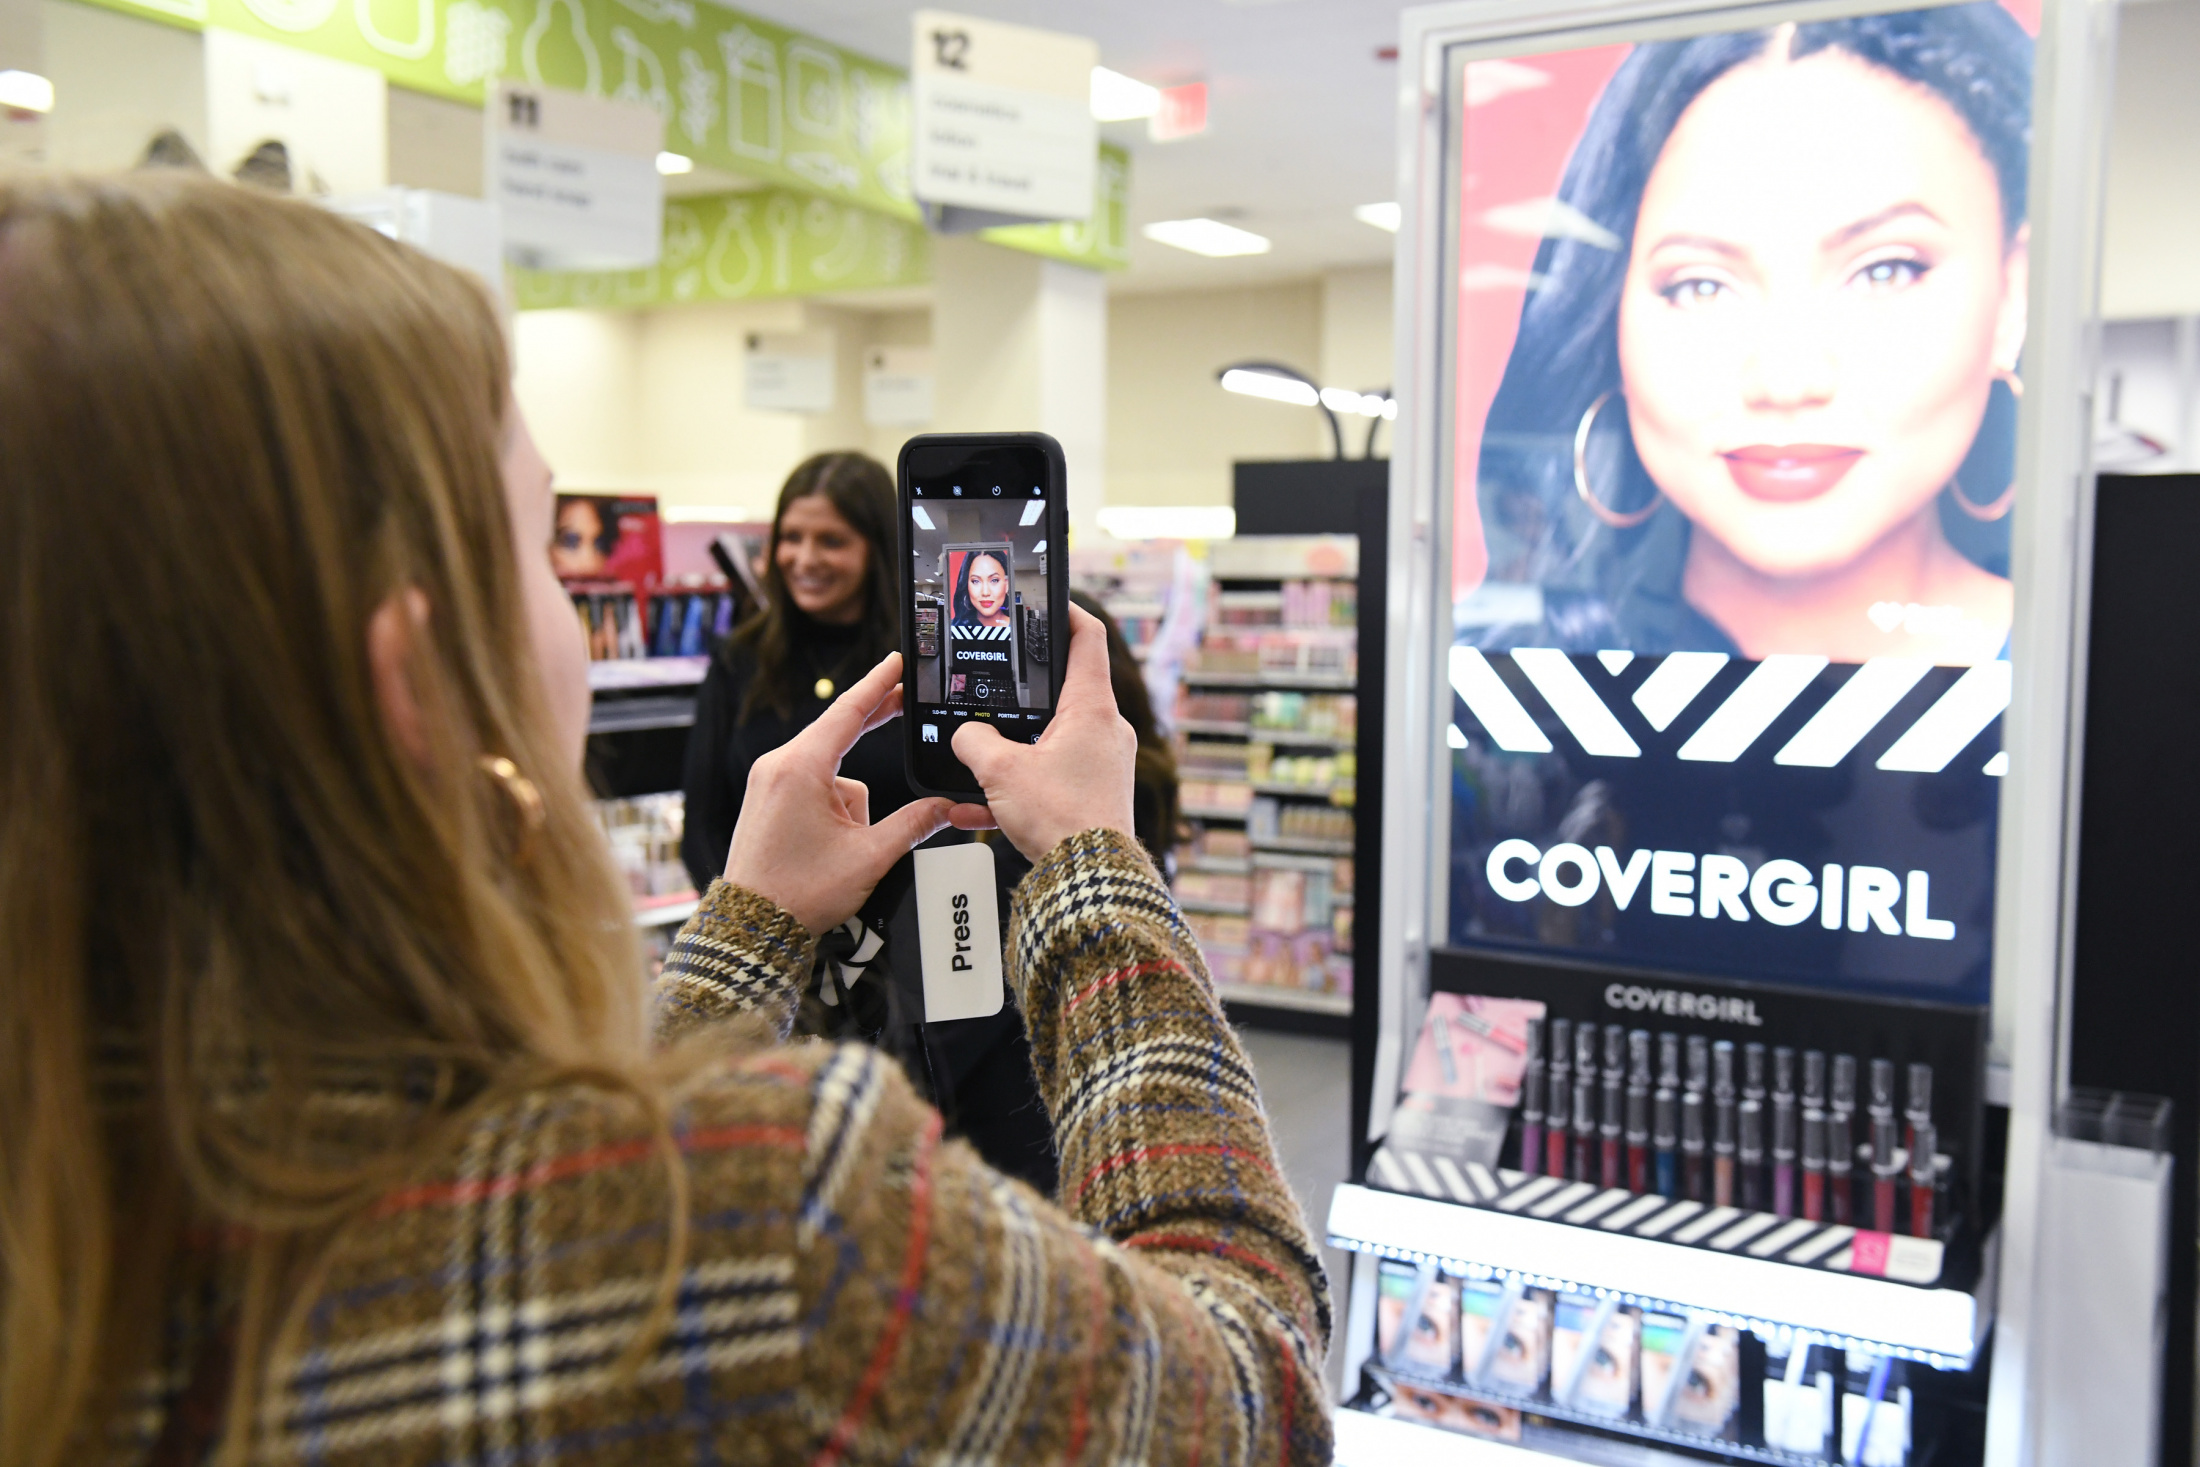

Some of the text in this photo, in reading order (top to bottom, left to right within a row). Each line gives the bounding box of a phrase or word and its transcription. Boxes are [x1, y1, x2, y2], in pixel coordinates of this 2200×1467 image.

[931, 29, 969, 71] 12
[508, 92, 539, 129] 11
[956, 650, 1008, 662] COVERGIRL
[1486, 838, 1956, 941] COVERGIRL
[951, 893, 973, 972] Press
[1604, 983, 1763, 1026] COVERGIRL
